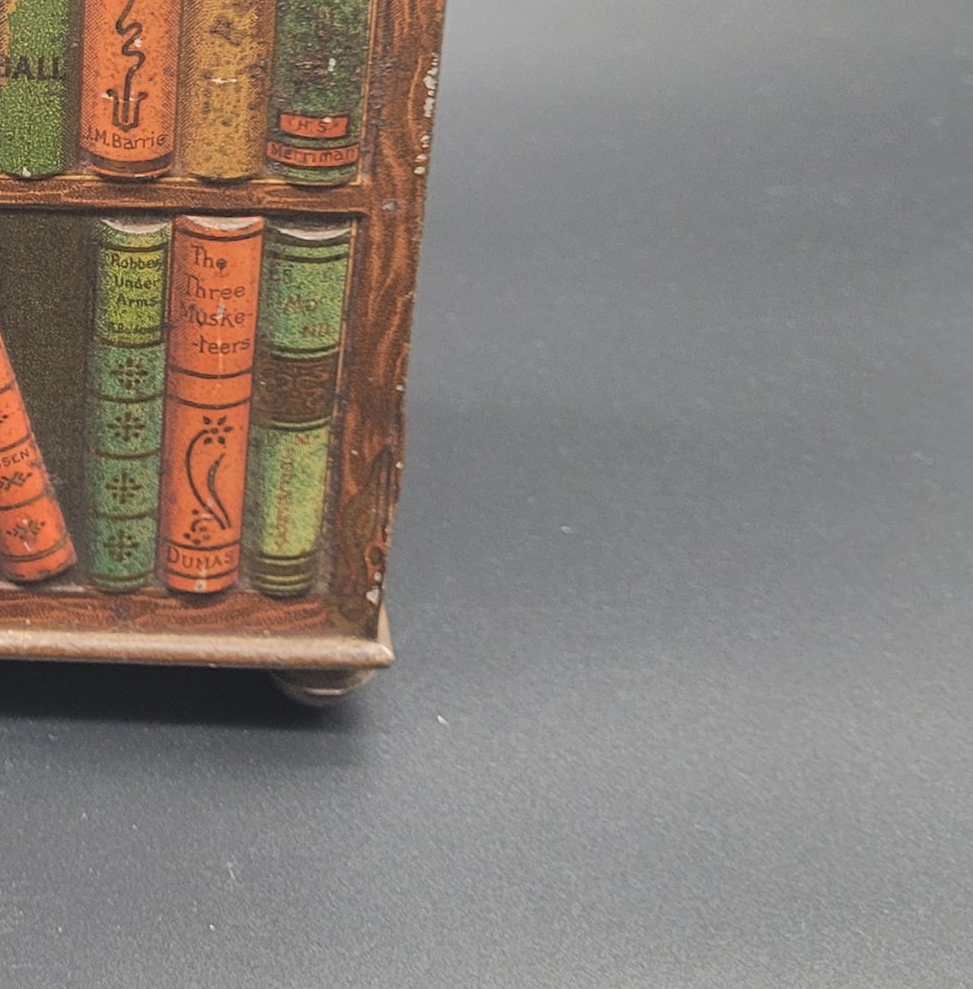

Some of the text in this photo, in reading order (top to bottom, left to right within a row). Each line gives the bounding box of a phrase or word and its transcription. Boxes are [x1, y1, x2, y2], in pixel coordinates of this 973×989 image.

[190, 242, 227, 270] The
[186, 272, 246, 301] Three
[167, 545, 234, 571] DUMAS
